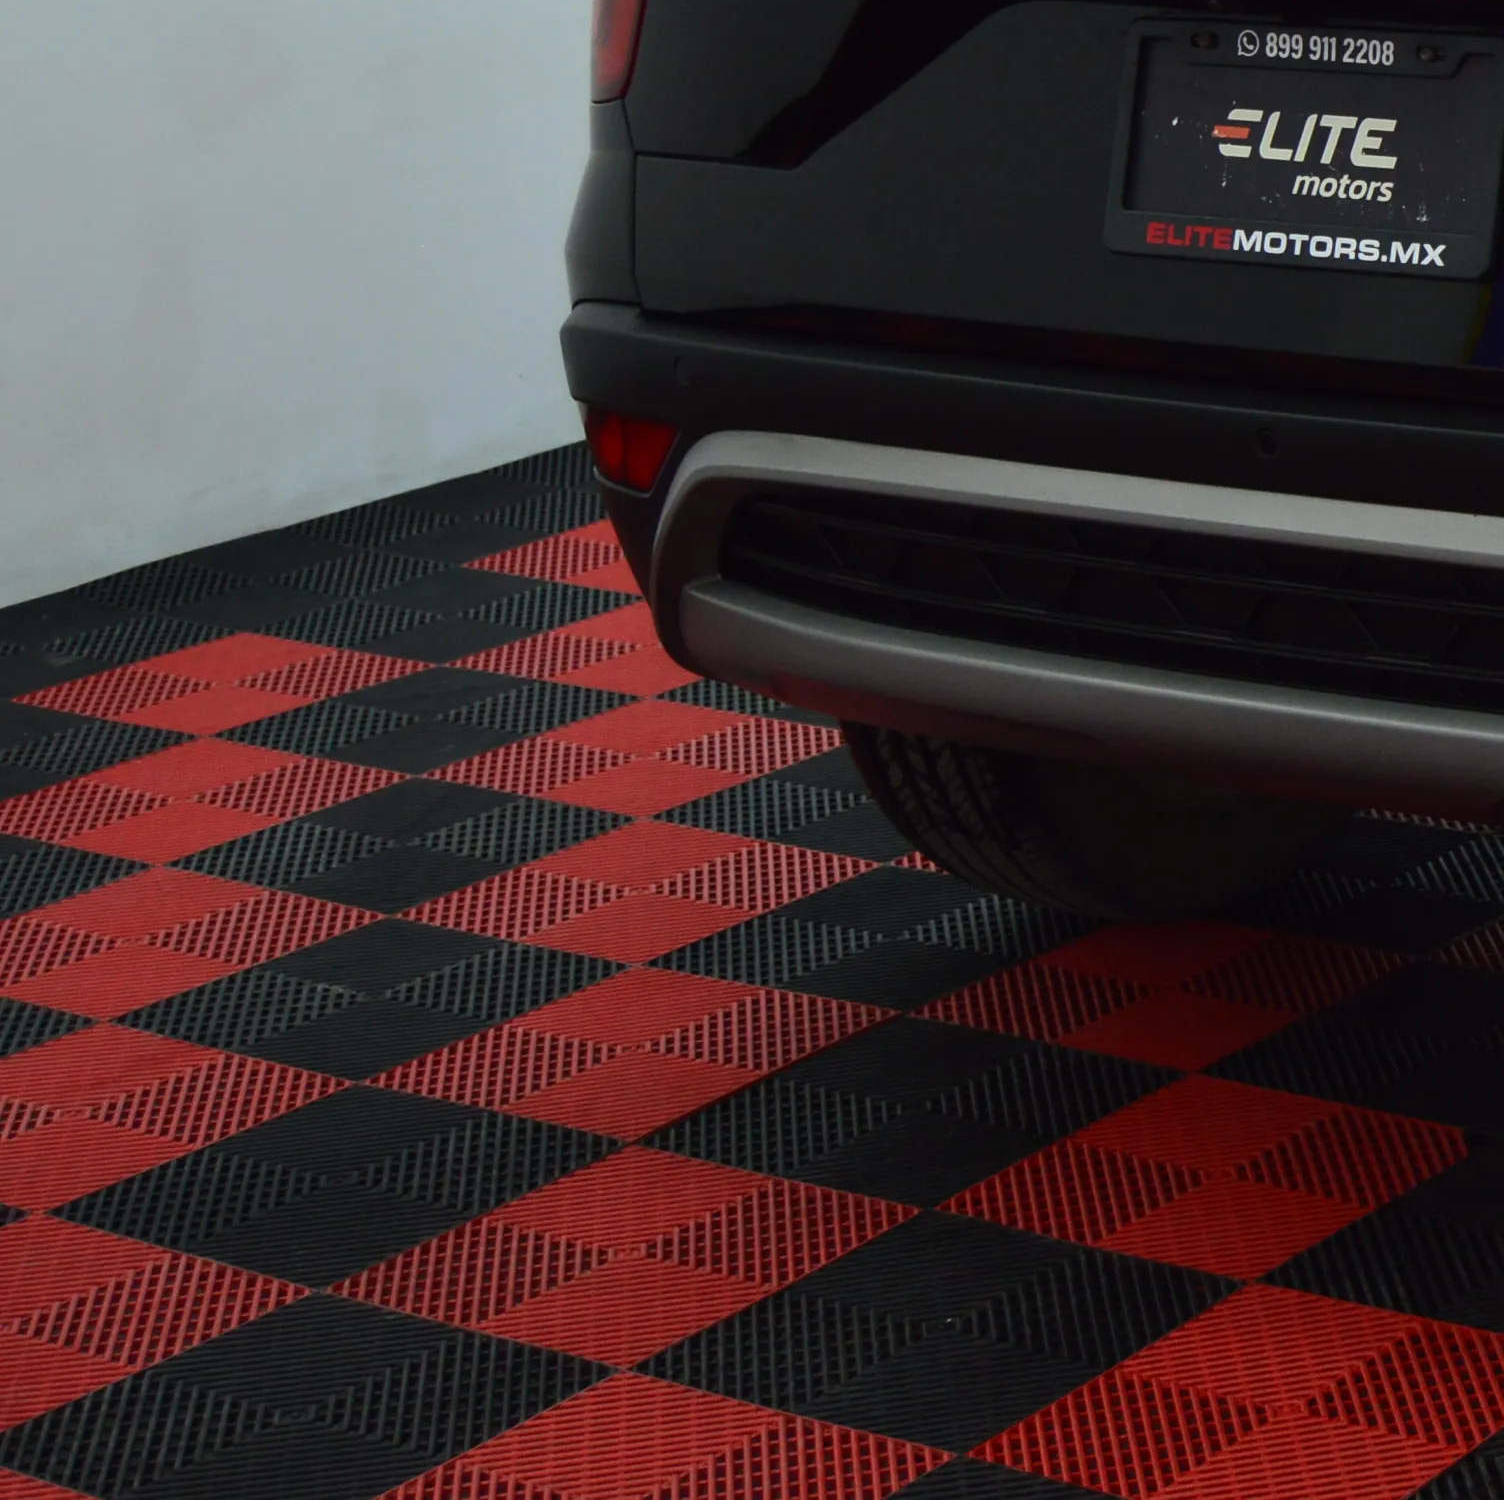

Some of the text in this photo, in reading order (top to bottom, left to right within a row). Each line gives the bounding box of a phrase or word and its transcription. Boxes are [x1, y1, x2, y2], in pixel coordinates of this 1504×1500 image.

[1265, 32, 1395, 66] 899 911 2208
[1211, 108, 1398, 170] ELITE
[1291, 173, 1395, 203] motors
[1145, 221, 1447, 267] ELITEMOTORS.MX
